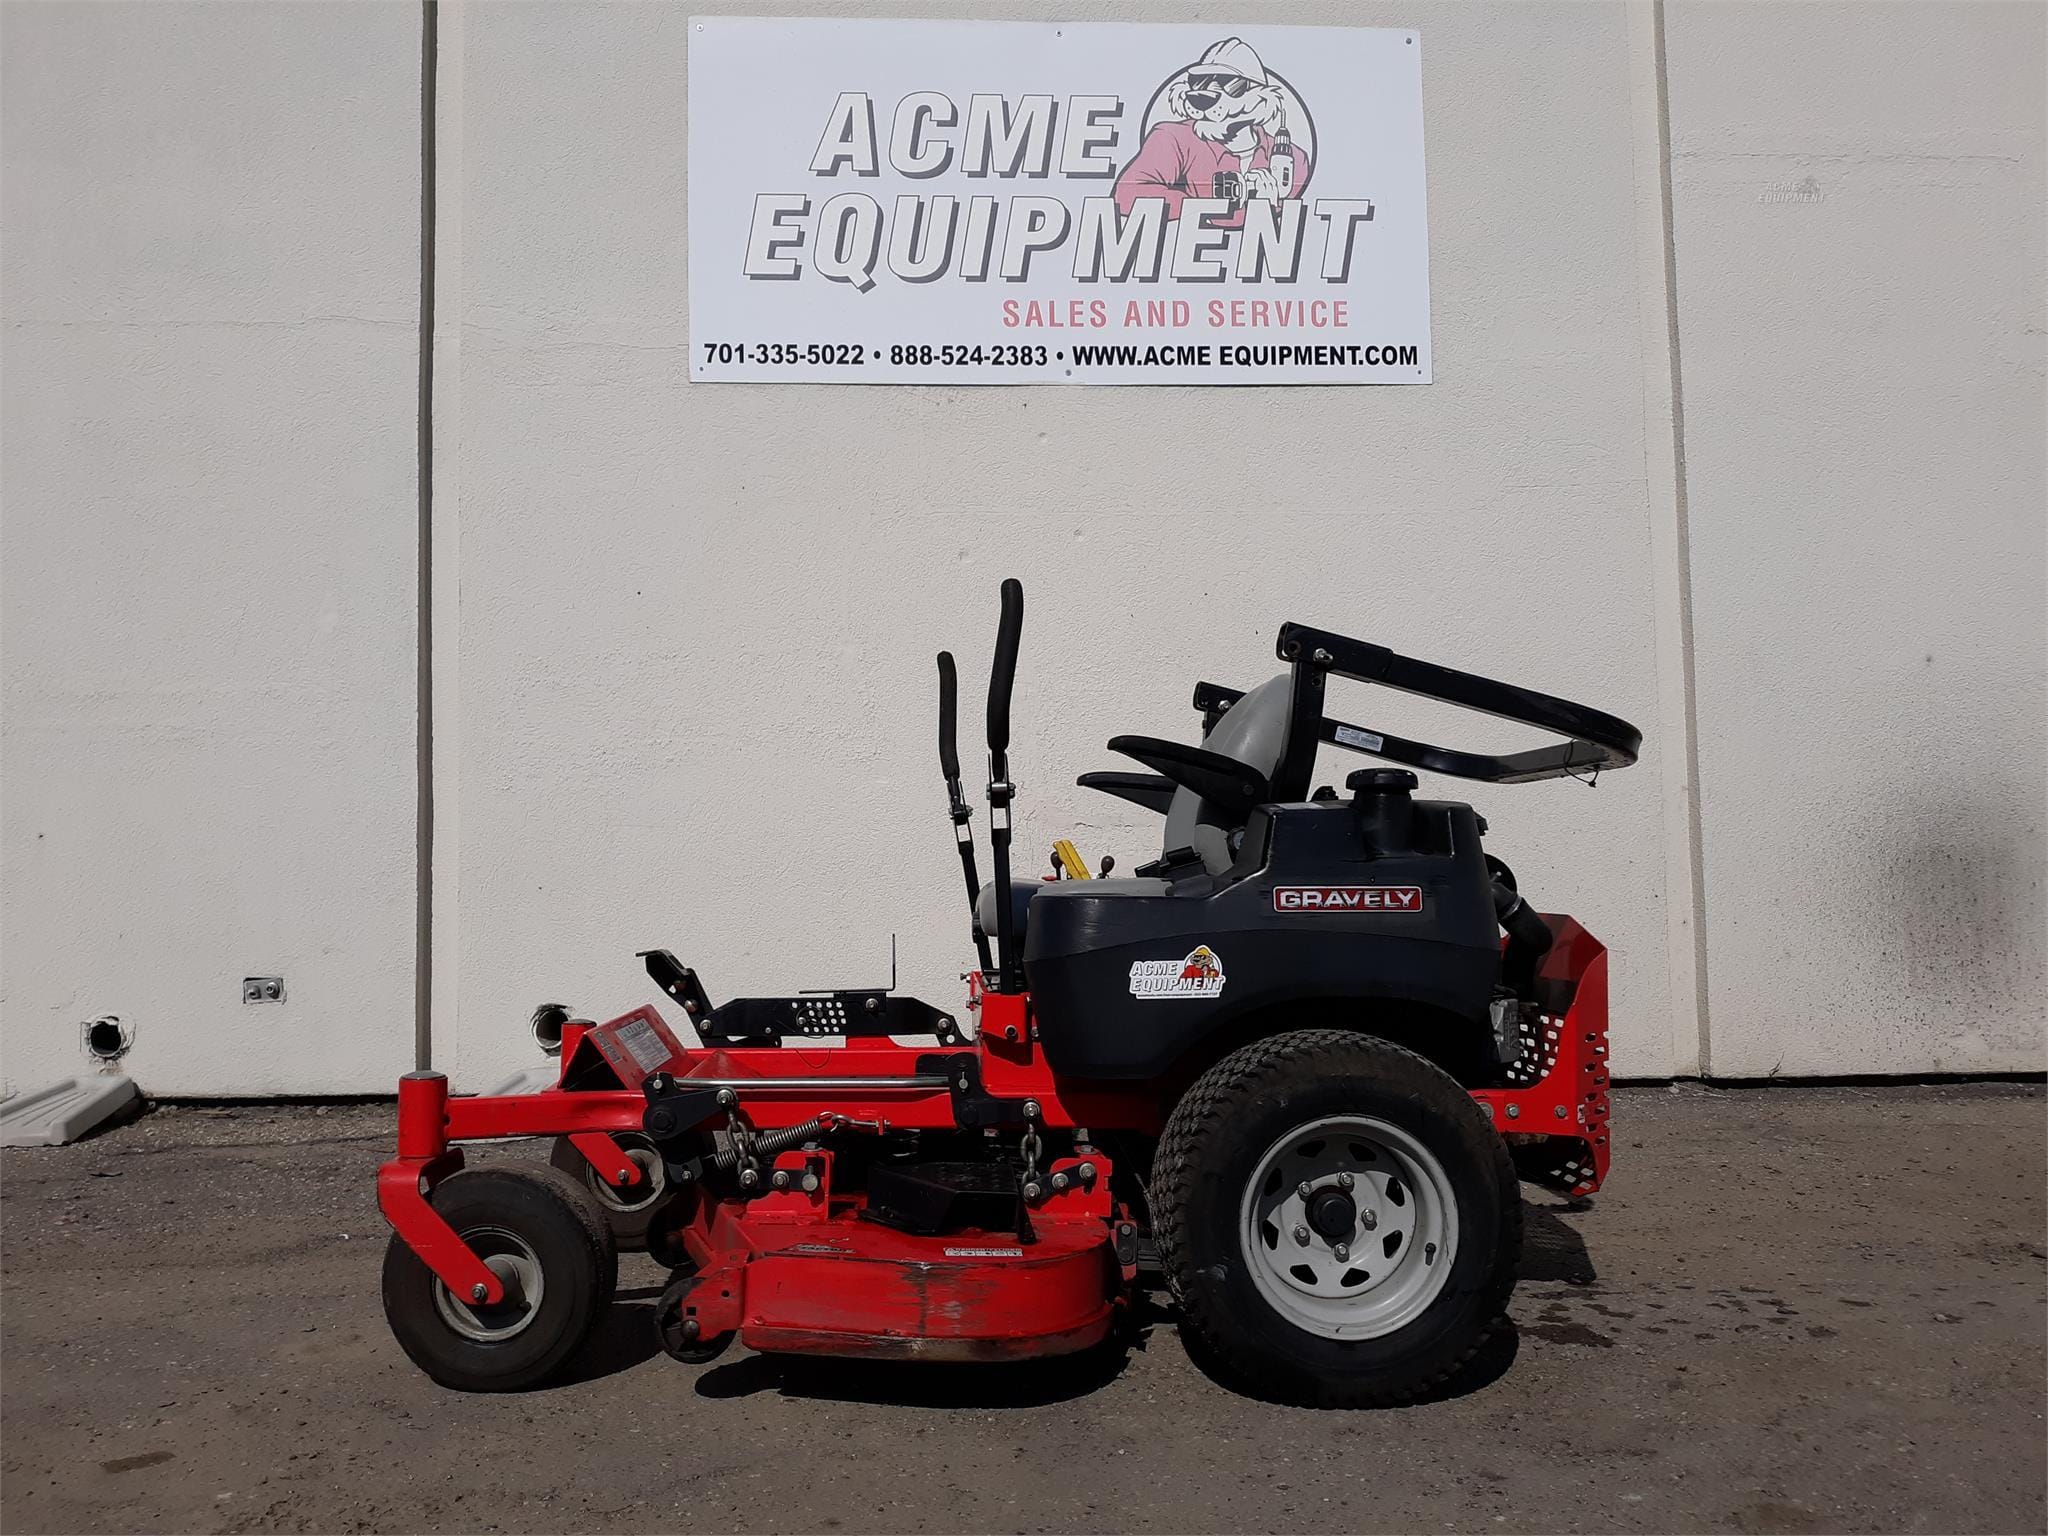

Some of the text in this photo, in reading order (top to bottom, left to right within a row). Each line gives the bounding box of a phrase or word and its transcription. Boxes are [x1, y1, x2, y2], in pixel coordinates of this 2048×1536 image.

[808, 90, 1123, 179] ACME
[742, 192, 1375, 293] EQUIPMENT
[1002, 299, 1349, 328] SALES AND SERVICE
[704, 343, 1419, 367] 701-335-5022 888-524-2383 WWW.ACME EQUIPMENT.COM
[1280, 890, 1416, 908] GRAVELY
[1132, 962, 1178, 977] ACME
[1131, 977, 1224, 993] EQUIPMENT
